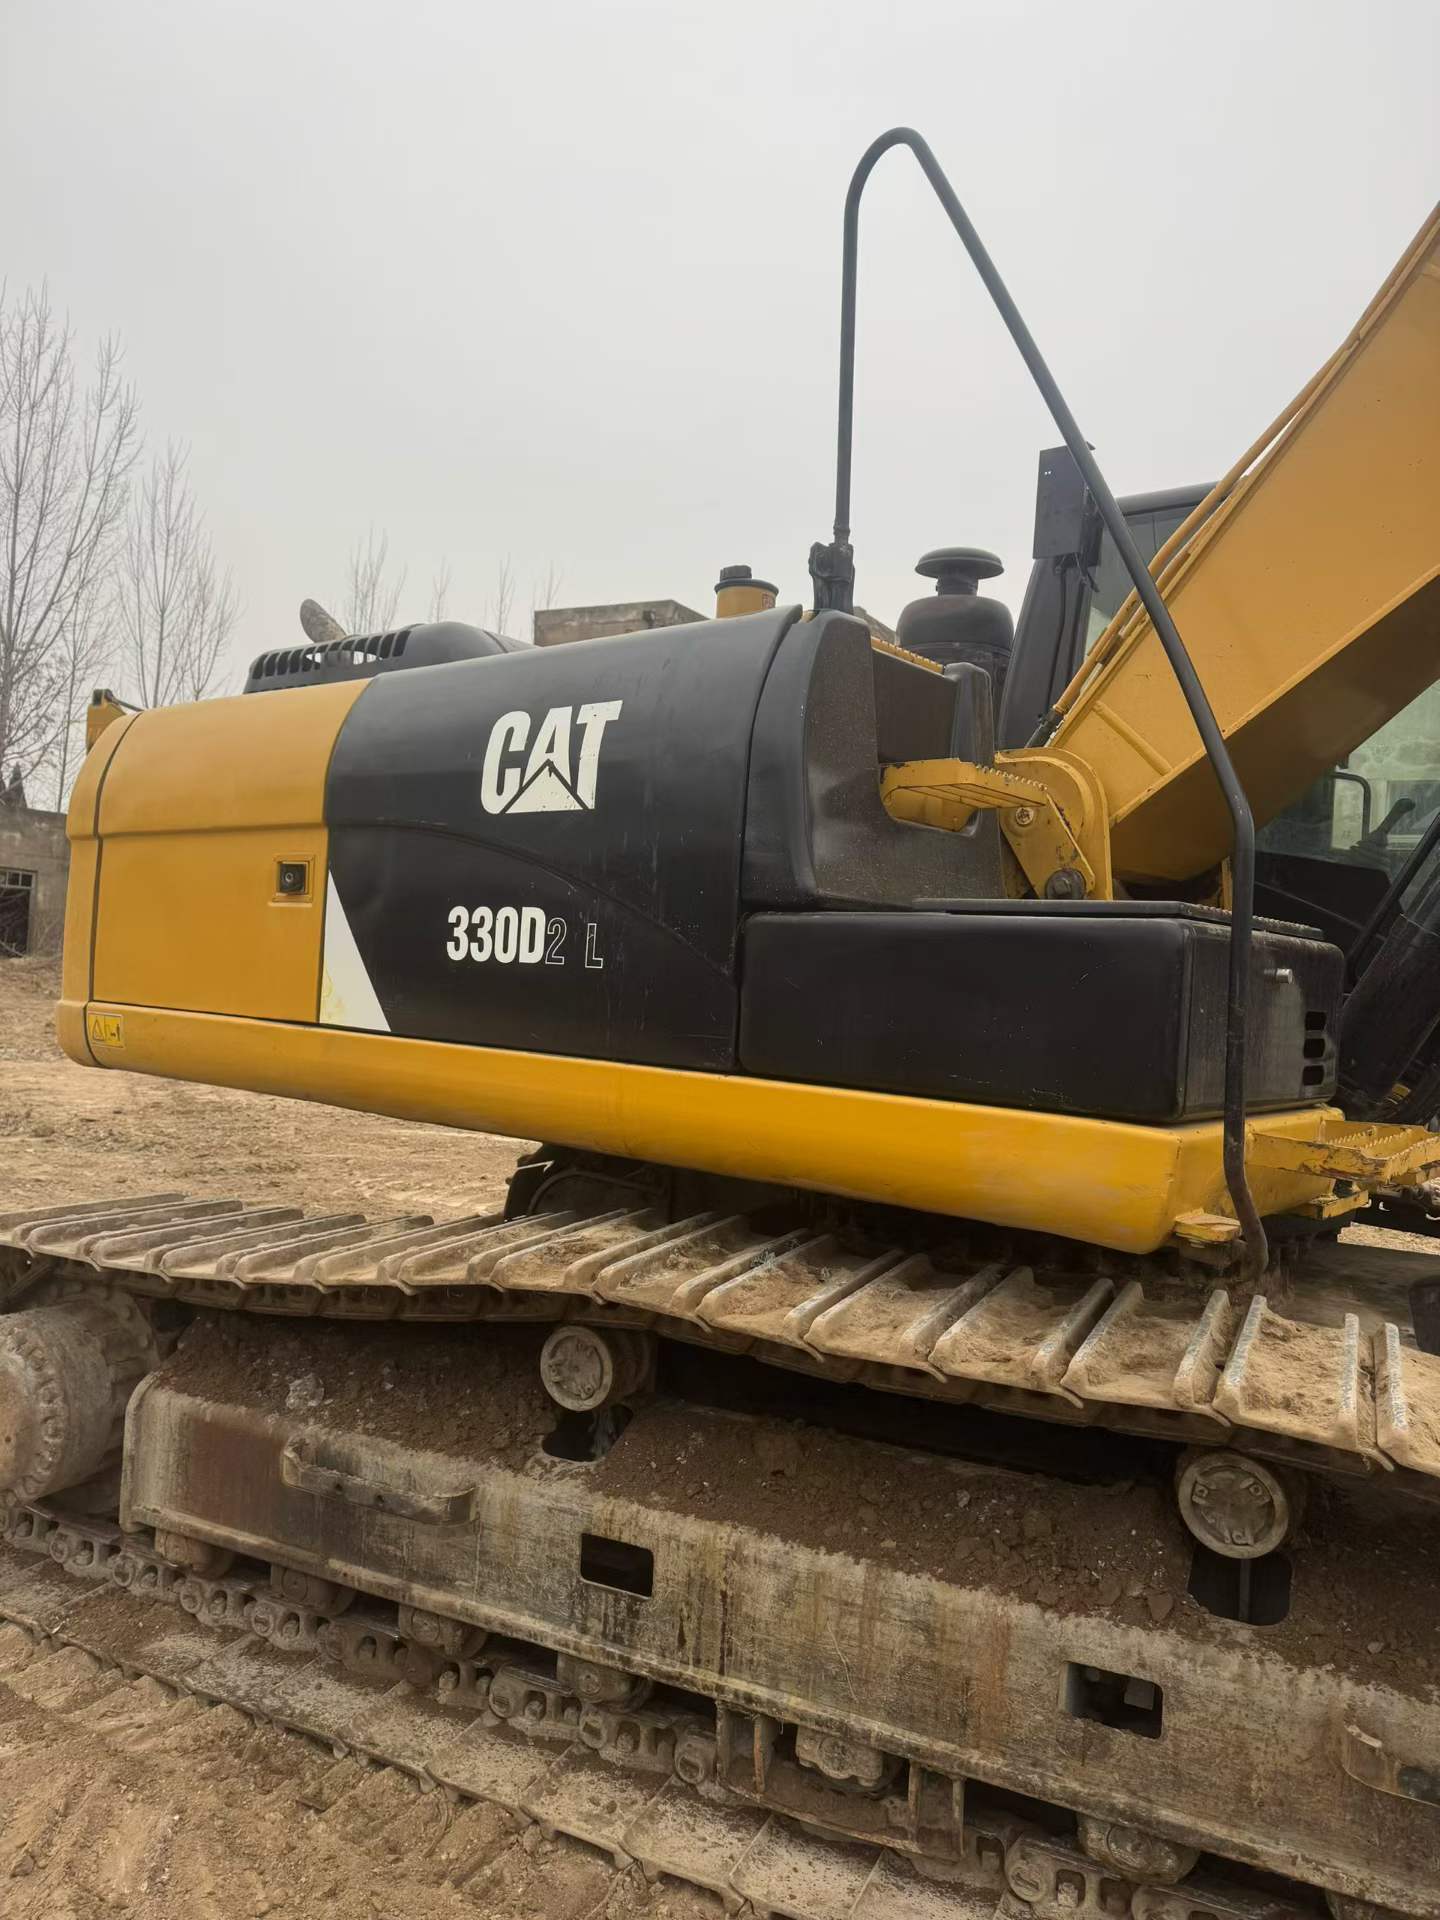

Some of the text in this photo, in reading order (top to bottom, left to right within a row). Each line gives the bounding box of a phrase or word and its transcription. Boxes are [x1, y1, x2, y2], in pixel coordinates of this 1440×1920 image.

[481, 700, 623, 814] CAT
[446, 906, 603, 968] 330D2 L
